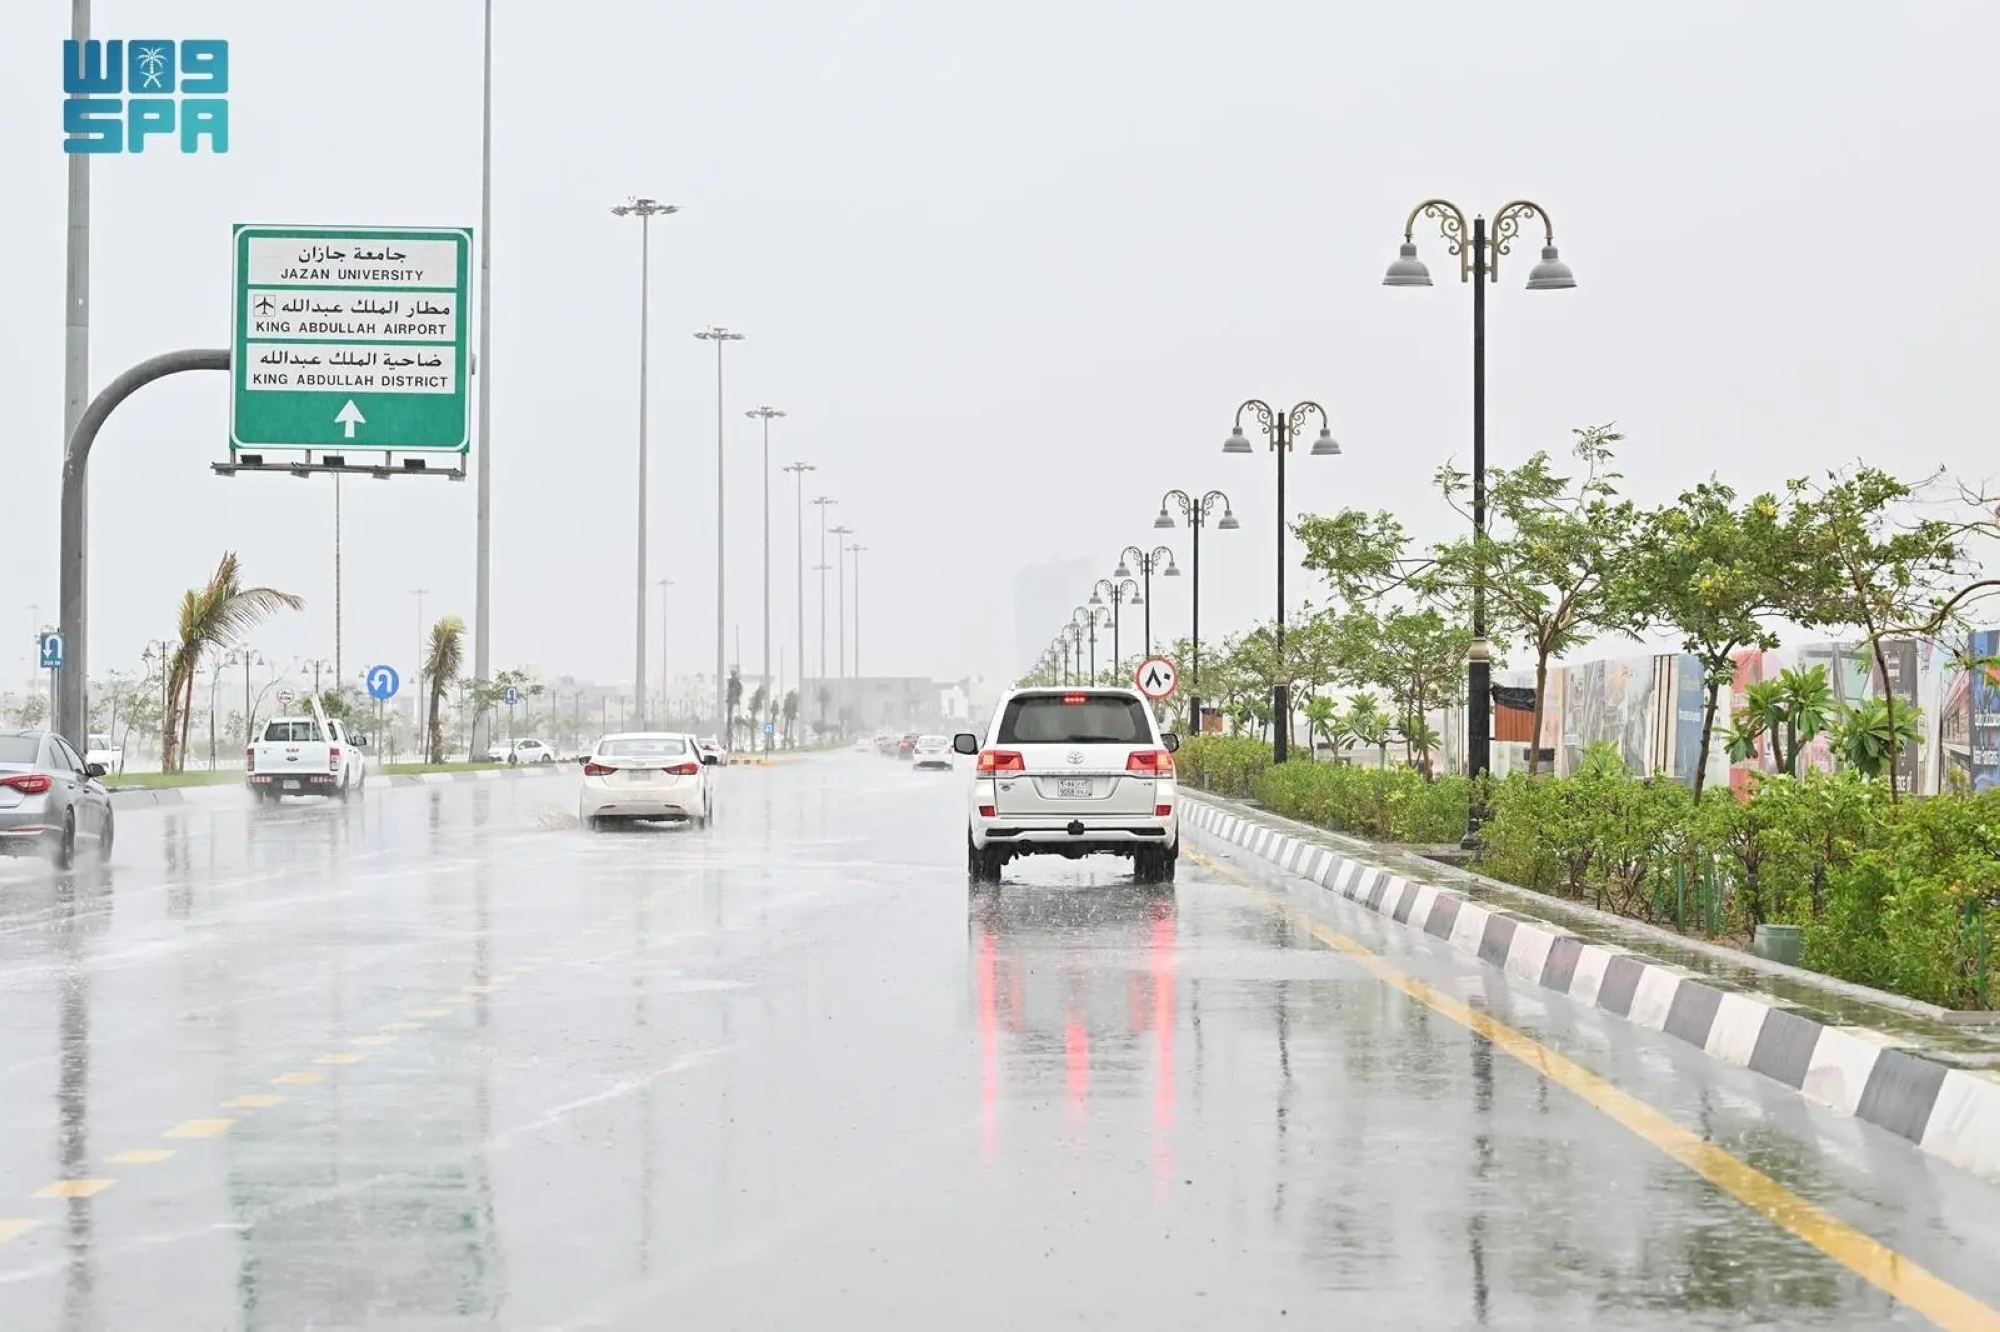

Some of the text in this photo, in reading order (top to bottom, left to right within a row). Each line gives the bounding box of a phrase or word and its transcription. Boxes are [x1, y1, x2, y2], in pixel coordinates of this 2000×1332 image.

[299, 246, 406, 263] جامعة جازان
[281, 269, 423, 280] JAZAN UNIVERSITY
[282, 299, 449, 318] مطار الملك عبدالله
[257, 322, 446, 334] KING ABDULLAH AIRPORT
[260, 351, 442, 370] ضاحية الملك عبدالله
[254, 374, 447, 387] KING ABDULLAH DISTRICT
